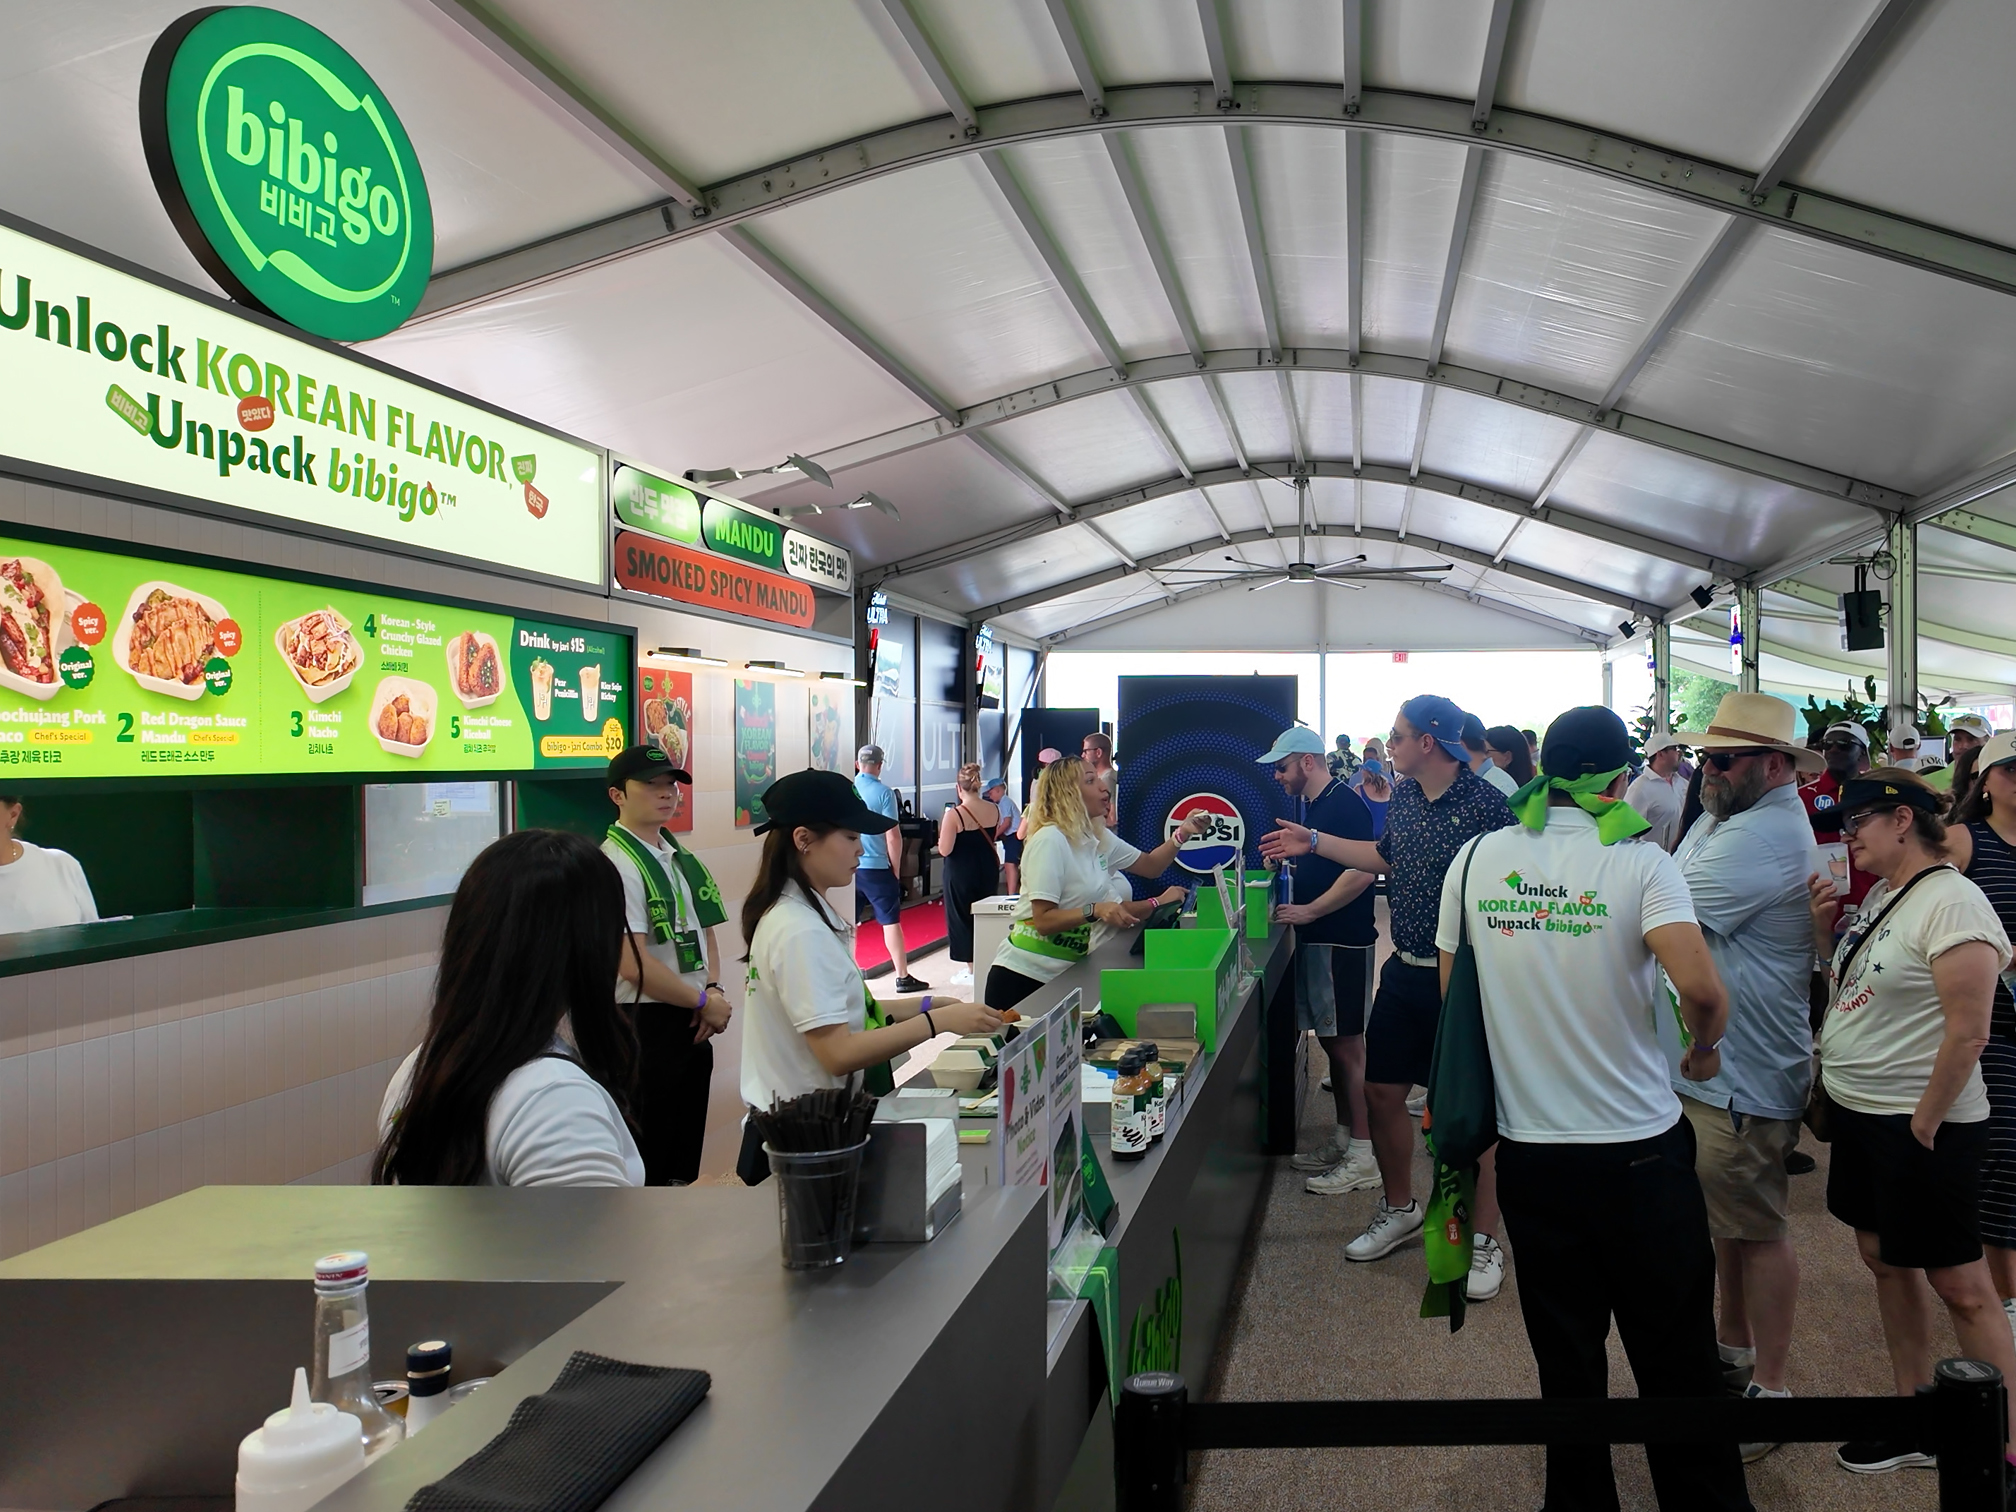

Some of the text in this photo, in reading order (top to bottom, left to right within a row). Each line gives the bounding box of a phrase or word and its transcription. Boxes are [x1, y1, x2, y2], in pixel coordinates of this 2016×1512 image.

[227, 86, 399, 245] bibigo
[260, 180, 337, 248] 비비고
[0, 269, 187, 382] Unlock
[196, 337, 376, 442] KOREAN
[110, 390, 148, 431] 비비고
[241, 406, 271, 422] 맛있다
[147, 392, 318, 486] Unpack
[528, 490, 544, 513] 한국
[629, 483, 659, 520] 만두
[715, 518, 774, 558] MANDU
[789, 540, 808, 570] 진짜
[809, 547, 835, 578] 한국의
[627, 546, 808, 618] SMOKED SPICY MANDU
[78, 616, 99, 627] Spicy
[364, 613, 377, 638] 4
[381, 614, 410, 628] Korean
[416, 619, 436, 632] Style
[84, 625, 99, 634] ver.
[219, 631, 236, 640] Spicy
[224, 639, 236, 647] ver.
[381, 629, 442, 646] Crunchy Glazed
[520, 630, 550, 650] Drink
[552, 640, 559, 650] by
[571, 637, 585, 653] $15
[381, 644, 413, 657] Chicken
[61, 660, 93, 673] Original
[72, 671, 87, 680] ver.
[205, 670, 231, 682] Original
[554, 678, 566, 687] Pear
[214, 679, 227, 688] ver.
[0, 708, 107, 727] ochujang Pork
[141, 711, 247, 729] Red Dragon Sauce
[291, 710, 304, 738] 3
[308, 710, 342, 723] Kimchi
[463, 715, 489, 726] Kimchi
[117, 712, 135, 743] 2
[308, 726, 338, 738] Nacho
[451, 716, 460, 739] 5
[741, 727, 772, 741] KOREAN
[34, 732, 87, 742] Chef's Special
[141, 730, 186, 744] Mandu
[606, 736, 622, 752] $20
[308, 743, 321, 755] 김치
[547, 741, 567, 753] bibigo
[571, 741, 581, 752] jari
[582, 742, 603, 751] Combo
[744, 740, 770, 751] FLAVOR
[922, 722, 985, 771] ULT
[21, 750, 41, 764] 제육
[42, 750, 62, 763] 타코
[141, 750, 215, 762] 레드 드래곤 소스 만두
[1817, 796, 1833, 811] hp
[1170, 825, 1240, 841] PSI
[1517, 883, 1568, 898] Unlock
[1478, 899, 1542, 913] KOREAN
[1487, 916, 1541, 931] Unpack
